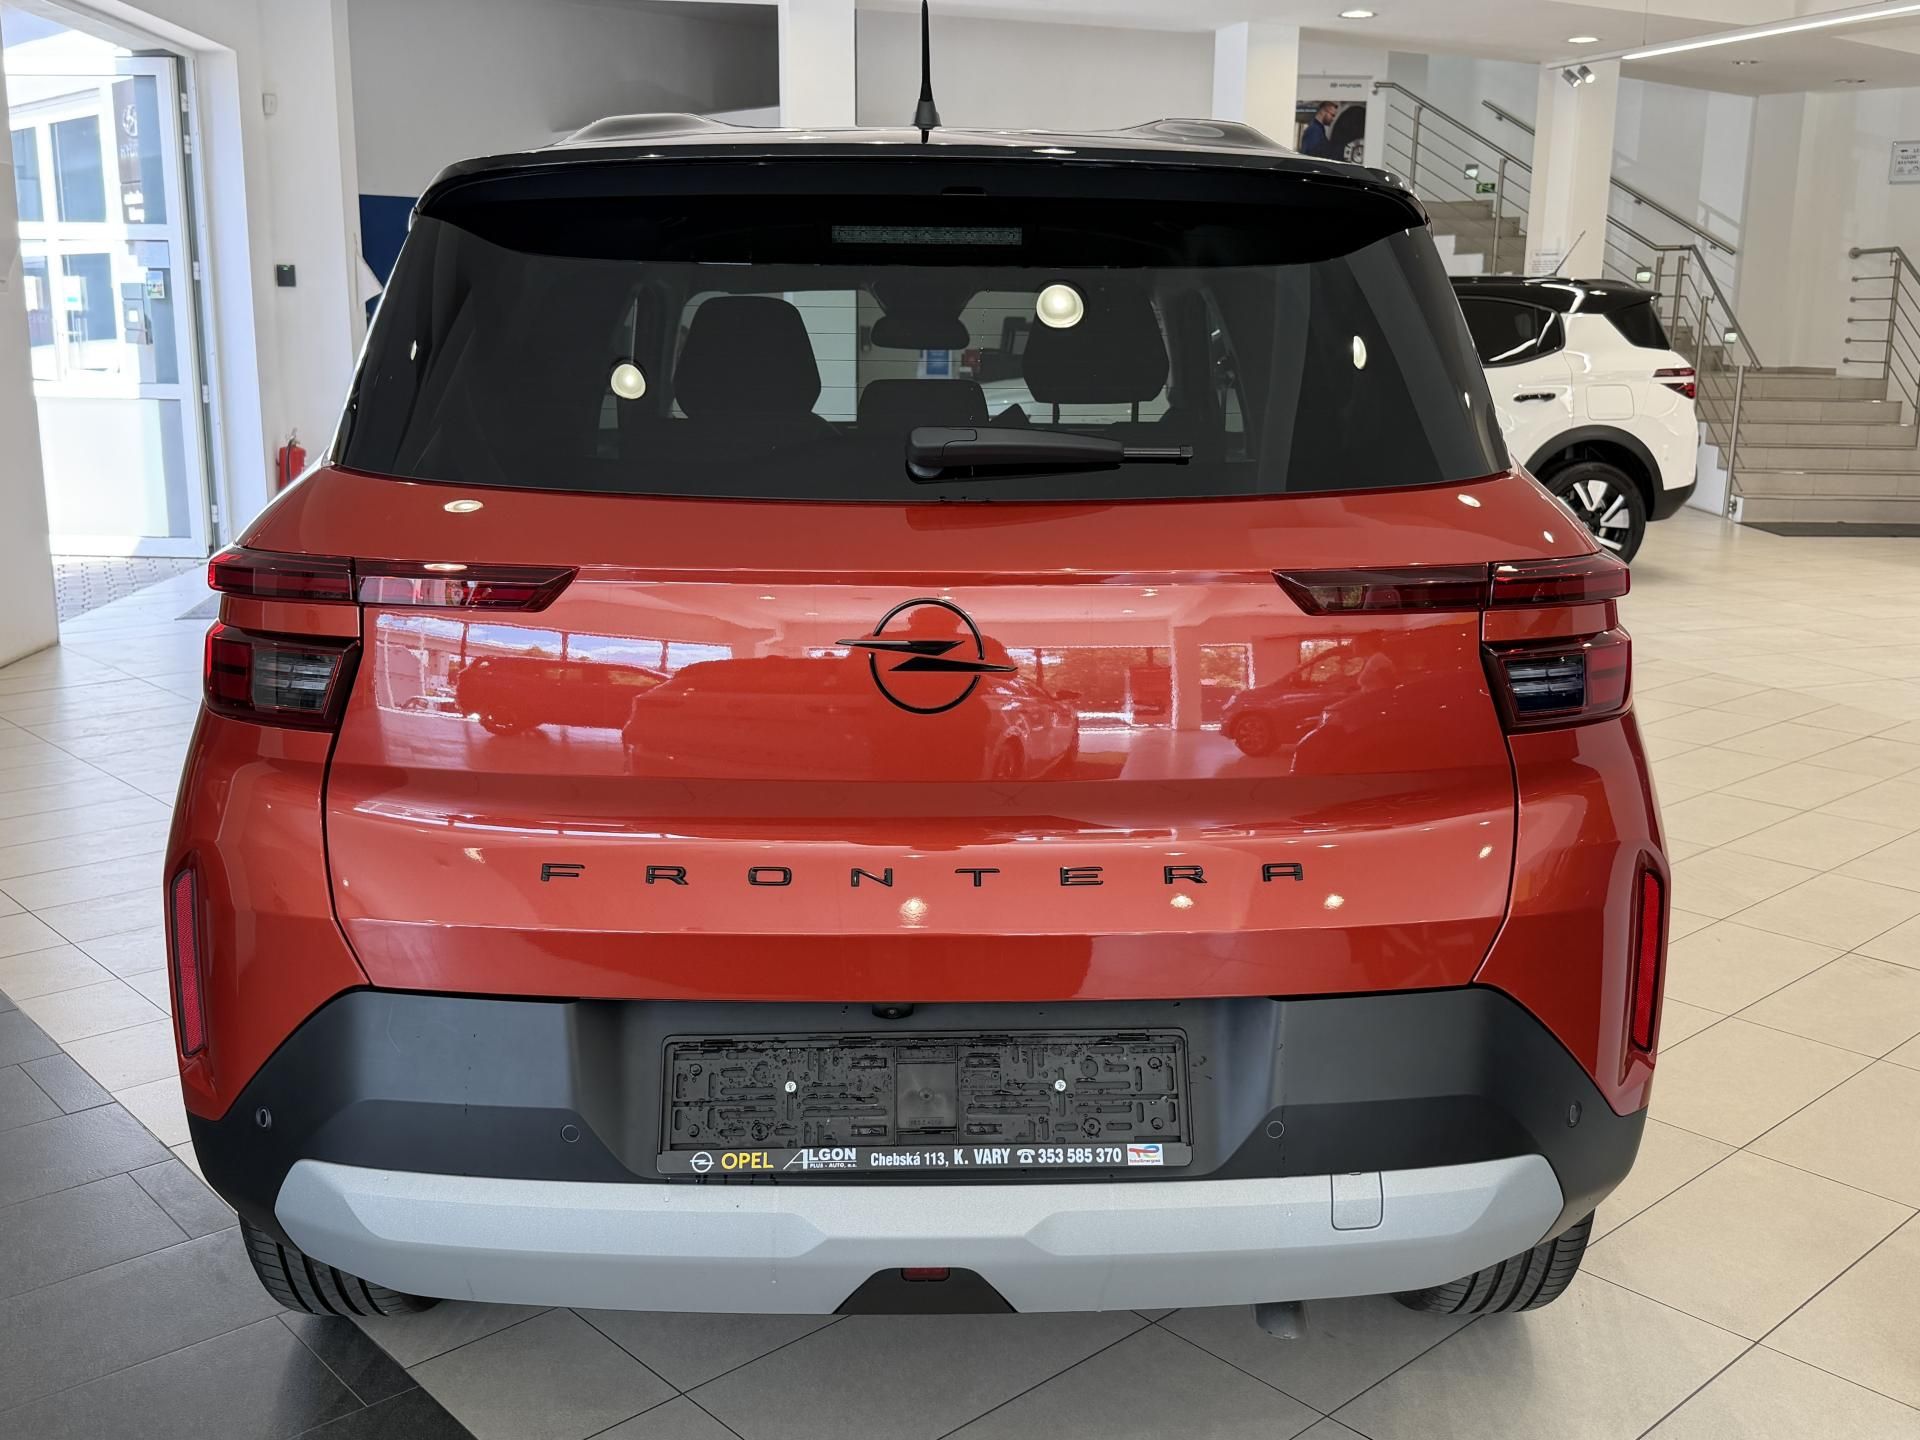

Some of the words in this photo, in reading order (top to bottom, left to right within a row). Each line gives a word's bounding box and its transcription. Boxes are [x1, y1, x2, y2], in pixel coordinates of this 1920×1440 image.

[540, 863, 1304, 886] FRONTERA
[721, 1152, 774, 1170] OPEL
[783, 1148, 857, 1170] ALGON
[870, 1152, 921, 1166] Chebská
[924, 1152, 949, 1168] 113,
[953, 1149, 969, 1165] K.
[973, 1148, 1011, 1165] VARY
[1038, 1148, 1064, 1164] 353
[1067, 1148, 1093, 1164] 585
[1096, 1147, 1122, 1163] 370
